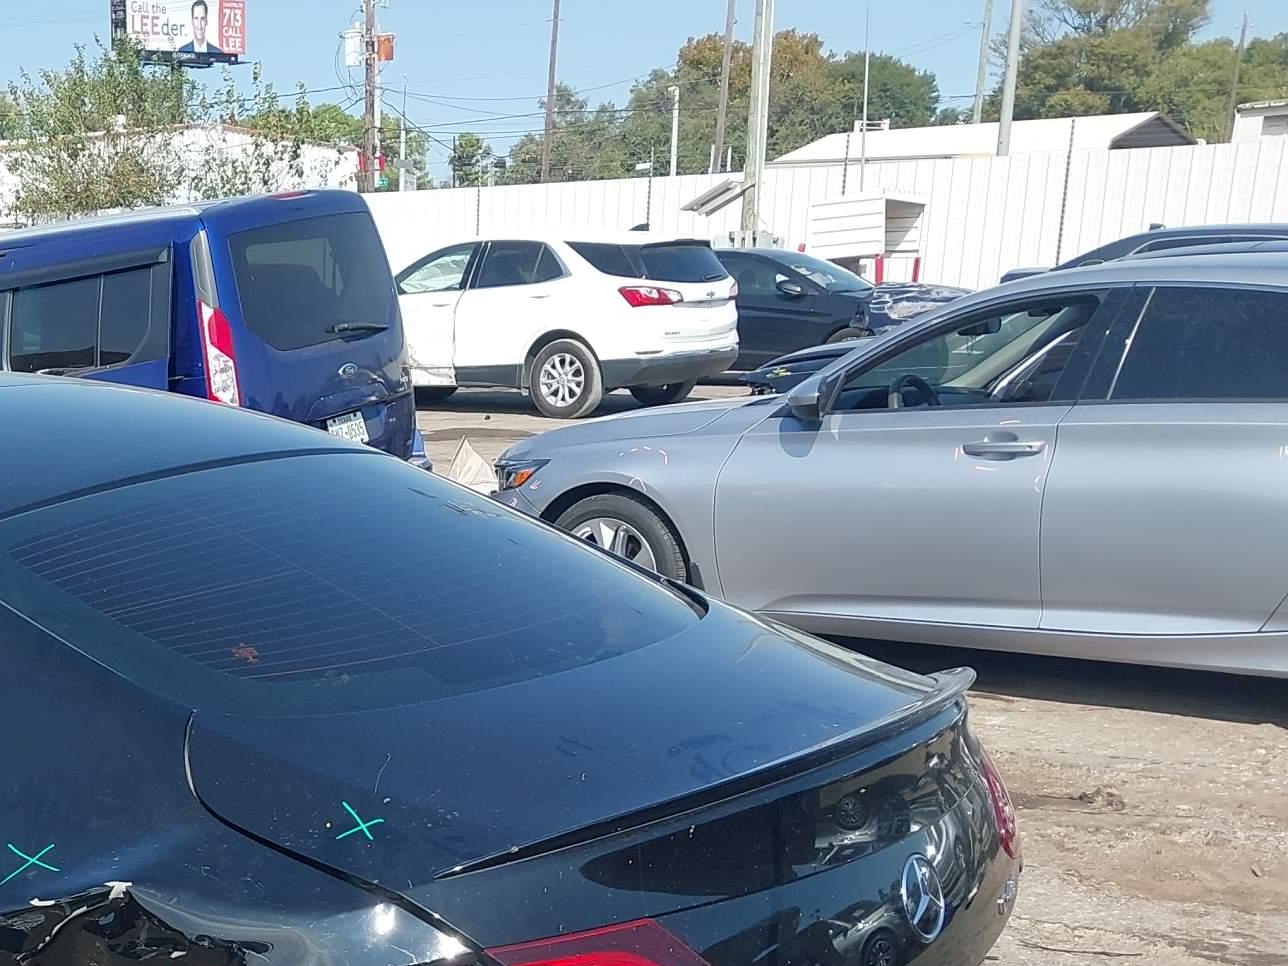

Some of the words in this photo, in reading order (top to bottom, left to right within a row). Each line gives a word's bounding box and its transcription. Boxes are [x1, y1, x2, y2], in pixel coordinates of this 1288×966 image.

[131, 1, 149, 14] Call
[152, 3, 167, 14] the
[223, 9, 242, 26] 713
[131, 15, 188, 37] LEEder.
[223, 26, 242, 37] CALL
[223, 37, 242, 52] LEE
